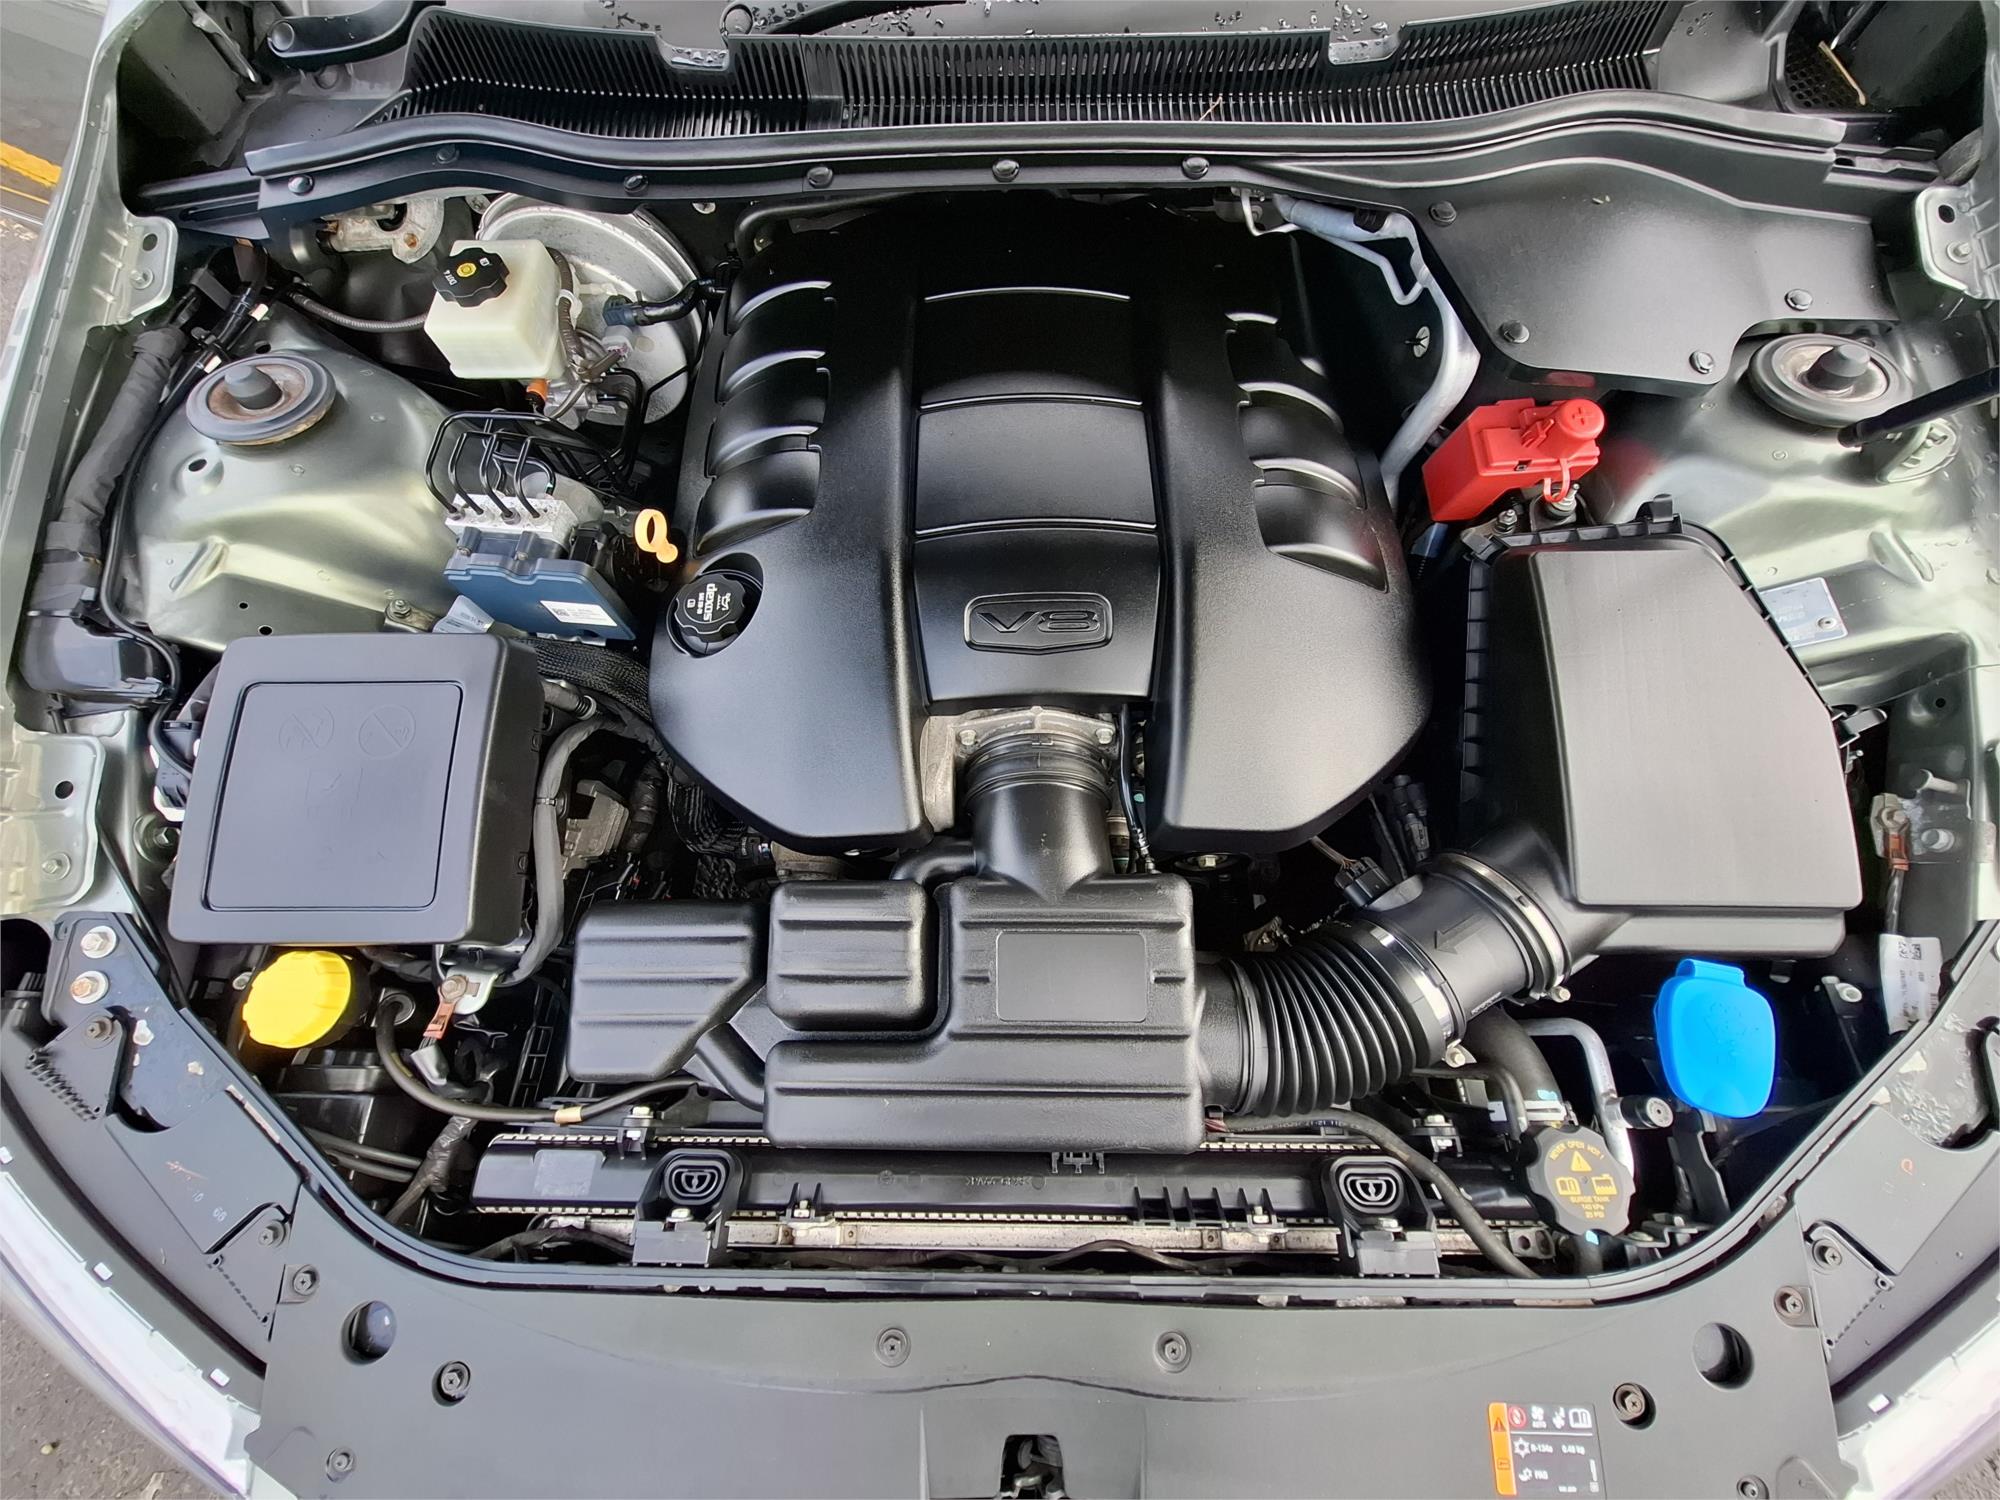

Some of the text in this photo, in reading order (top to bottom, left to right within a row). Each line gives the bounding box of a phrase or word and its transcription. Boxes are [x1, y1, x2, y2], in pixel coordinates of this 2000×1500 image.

[703, 583, 717, 621] dexos
[976, 609, 1101, 634] V8
[1567, 1141, 1585, 1149] OPEN
